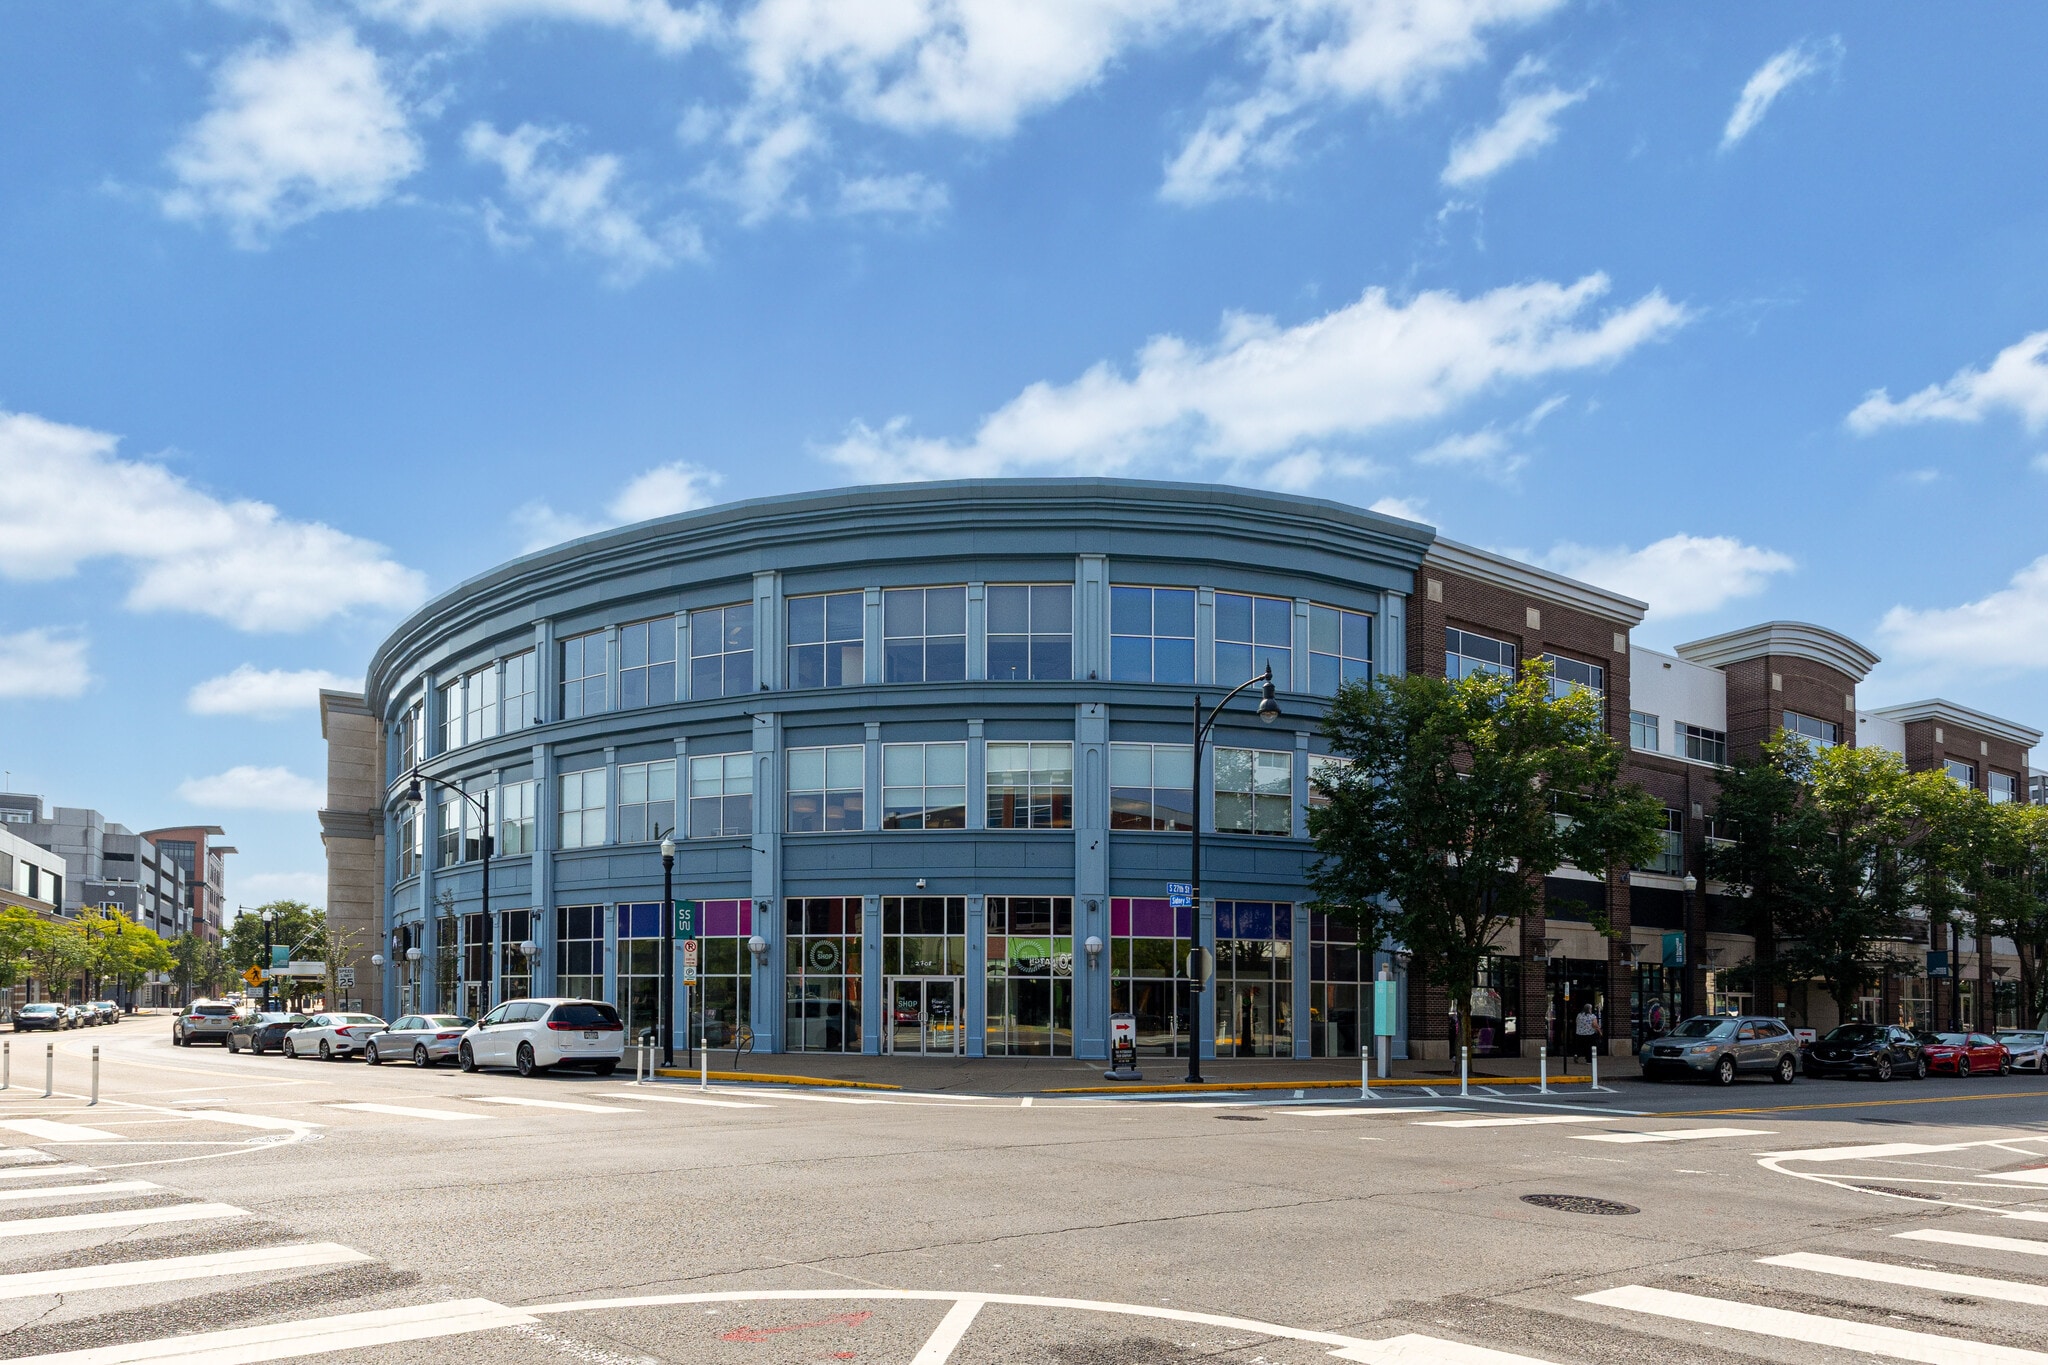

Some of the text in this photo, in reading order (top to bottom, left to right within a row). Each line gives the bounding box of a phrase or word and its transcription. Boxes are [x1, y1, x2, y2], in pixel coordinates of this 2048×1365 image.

[1169, 884, 1190, 894] S 27th St
[1172, 896, 1191, 906] Sidney St
[679, 908, 691, 920] SS
[339, 978, 354, 987] 25
[898, 1000, 918, 1008] SHOP
